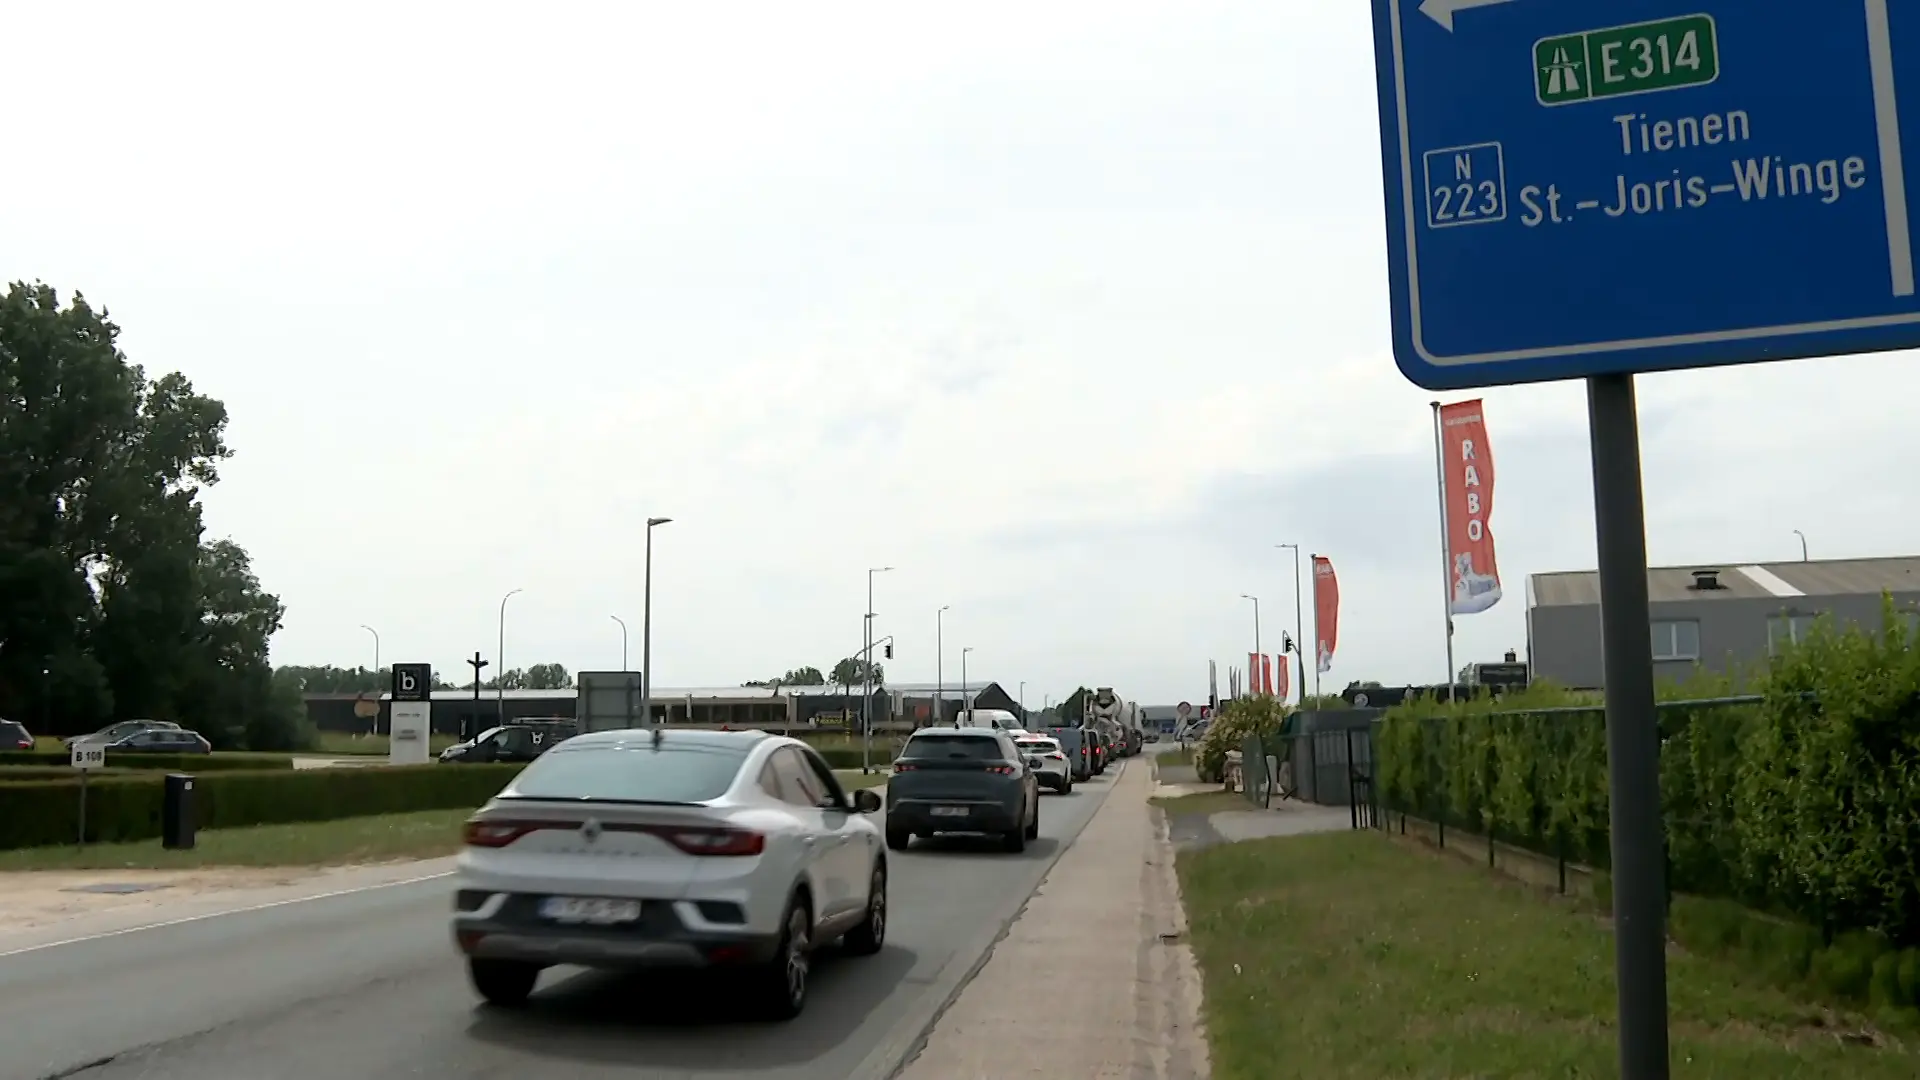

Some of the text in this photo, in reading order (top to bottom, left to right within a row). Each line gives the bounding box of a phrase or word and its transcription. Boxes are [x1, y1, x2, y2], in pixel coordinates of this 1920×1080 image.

[1602, 30, 1701, 84] E314
[1613, 109, 1750, 156] Tienen
[1454, 153, 1472, 181] N
[1433, 181, 1499, 221] 223
[1519, 155, 1867, 228] St.-Joris-Winge
[1462, 439, 1482, 541] RABO
[76, 751, 83, 761] B
